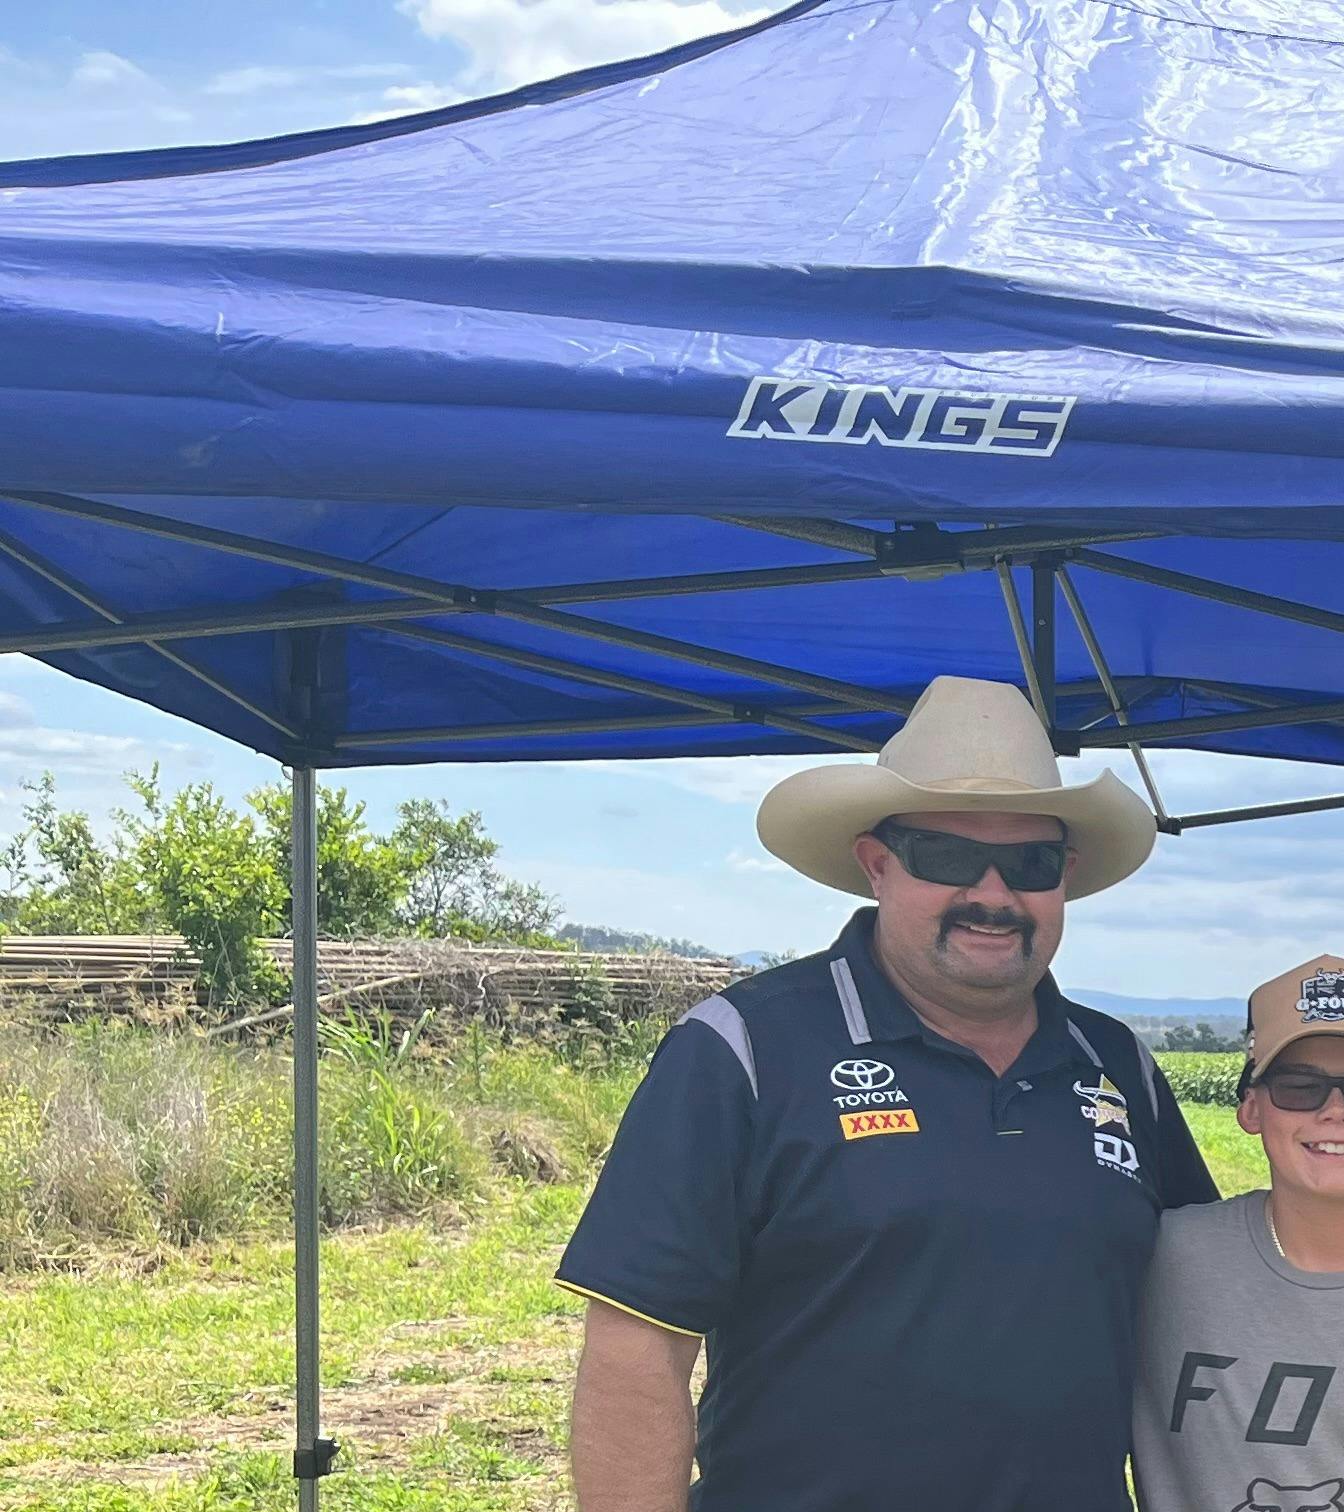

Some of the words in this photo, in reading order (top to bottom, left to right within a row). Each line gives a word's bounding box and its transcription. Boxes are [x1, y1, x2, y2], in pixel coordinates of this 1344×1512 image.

[738, 382, 1066, 451] KINGS
[833, 1089, 909, 1109] TOYOTA
[848, 1113, 911, 1133] XXXX
